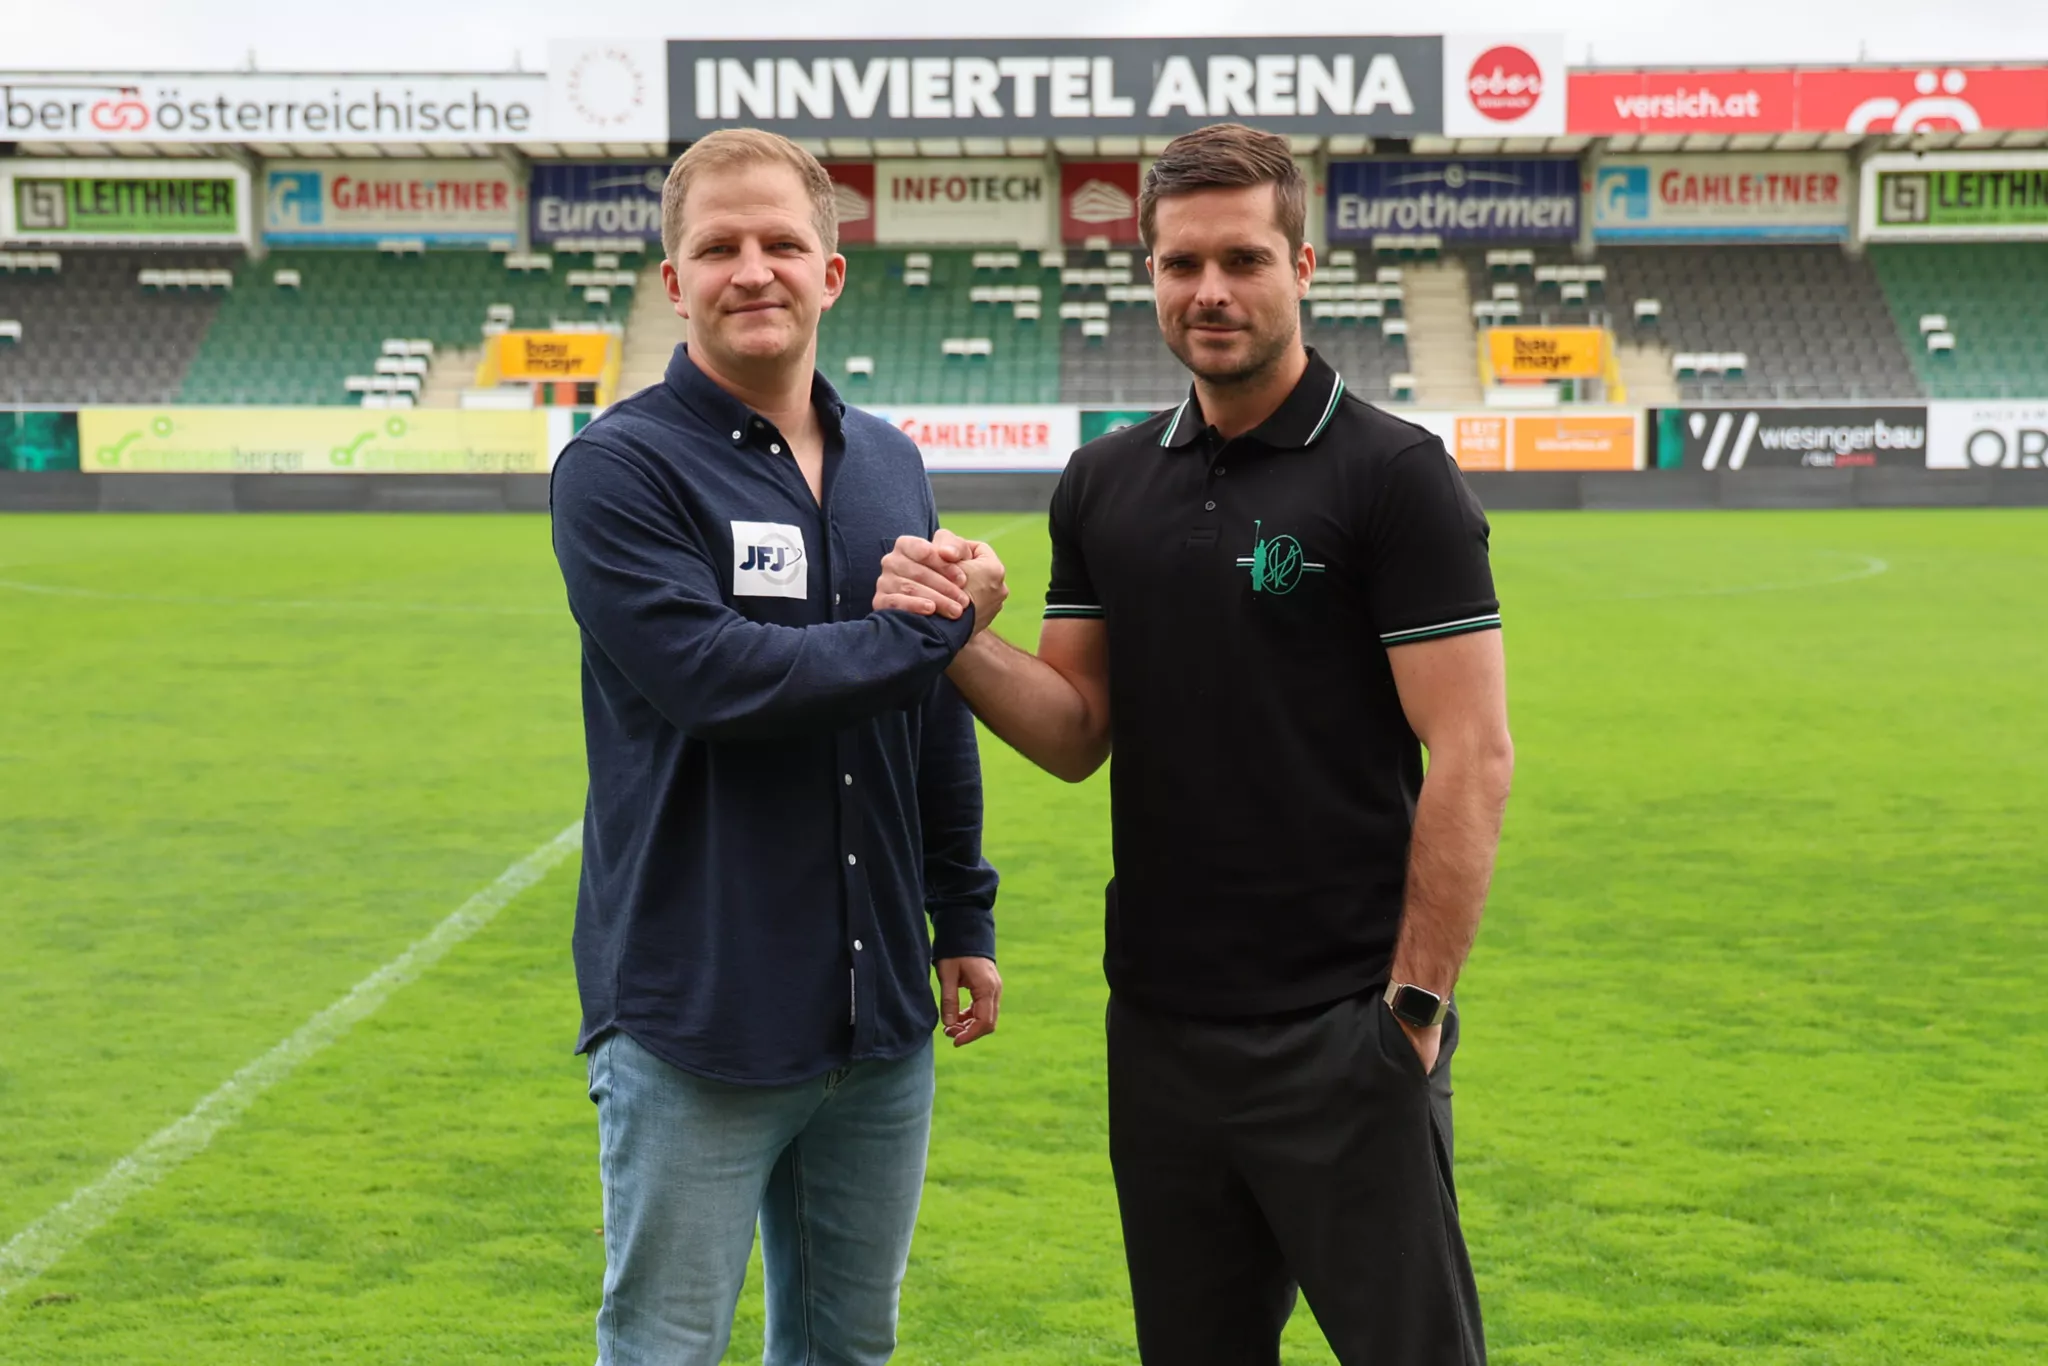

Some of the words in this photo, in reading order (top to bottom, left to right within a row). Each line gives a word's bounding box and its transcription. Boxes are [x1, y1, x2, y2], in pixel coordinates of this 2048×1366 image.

[694, 57, 1135, 119] INNVIERTEL
[1147, 53, 1414, 116] ARENA
[1613, 87, 1761, 119] versich.at
[0, 86, 84, 131] ber
[156, 90, 532, 132] österreichische
[74, 180, 232, 216] LEITHNER
[892, 176, 1042, 202] INFOTECH
[1337, 191, 1575, 230] Eurothermen
[1758, 417, 1924, 455] wiesingerbau
[739, 545, 785, 572] JFJ
